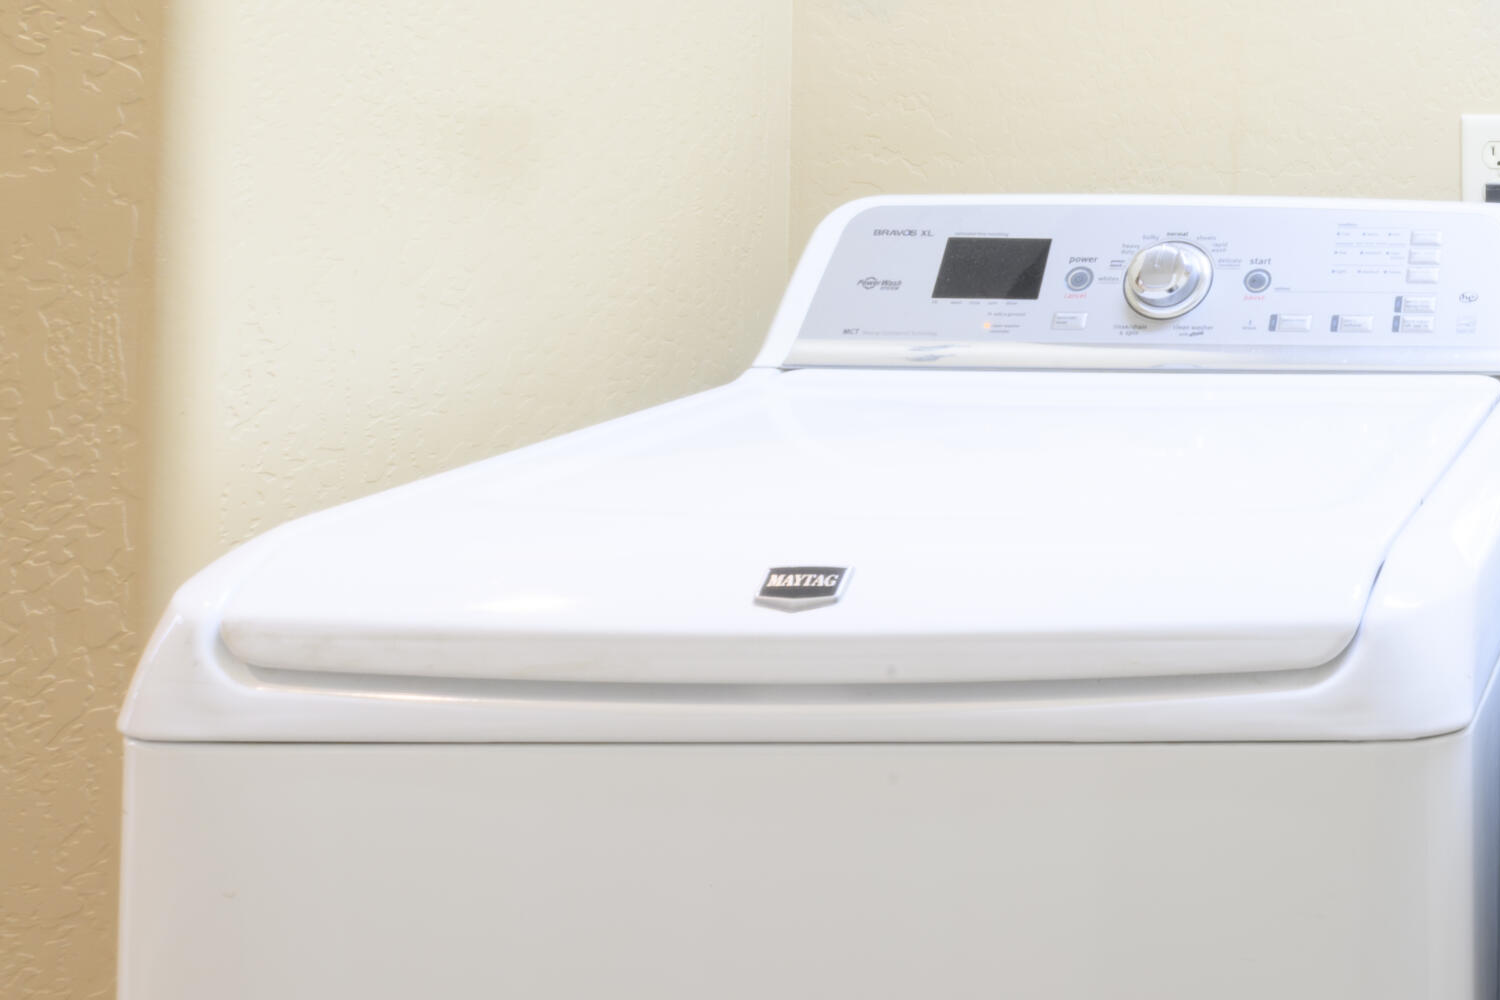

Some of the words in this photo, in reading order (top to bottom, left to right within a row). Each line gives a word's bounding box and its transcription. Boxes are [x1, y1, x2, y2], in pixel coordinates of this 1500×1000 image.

[872, 229, 917, 237] BRAVOS
[920, 229, 935, 237] XL
[1069, 256, 1099, 265] power
[1249, 257, 1272, 265] start
[766, 573, 839, 588] MAYTAG
